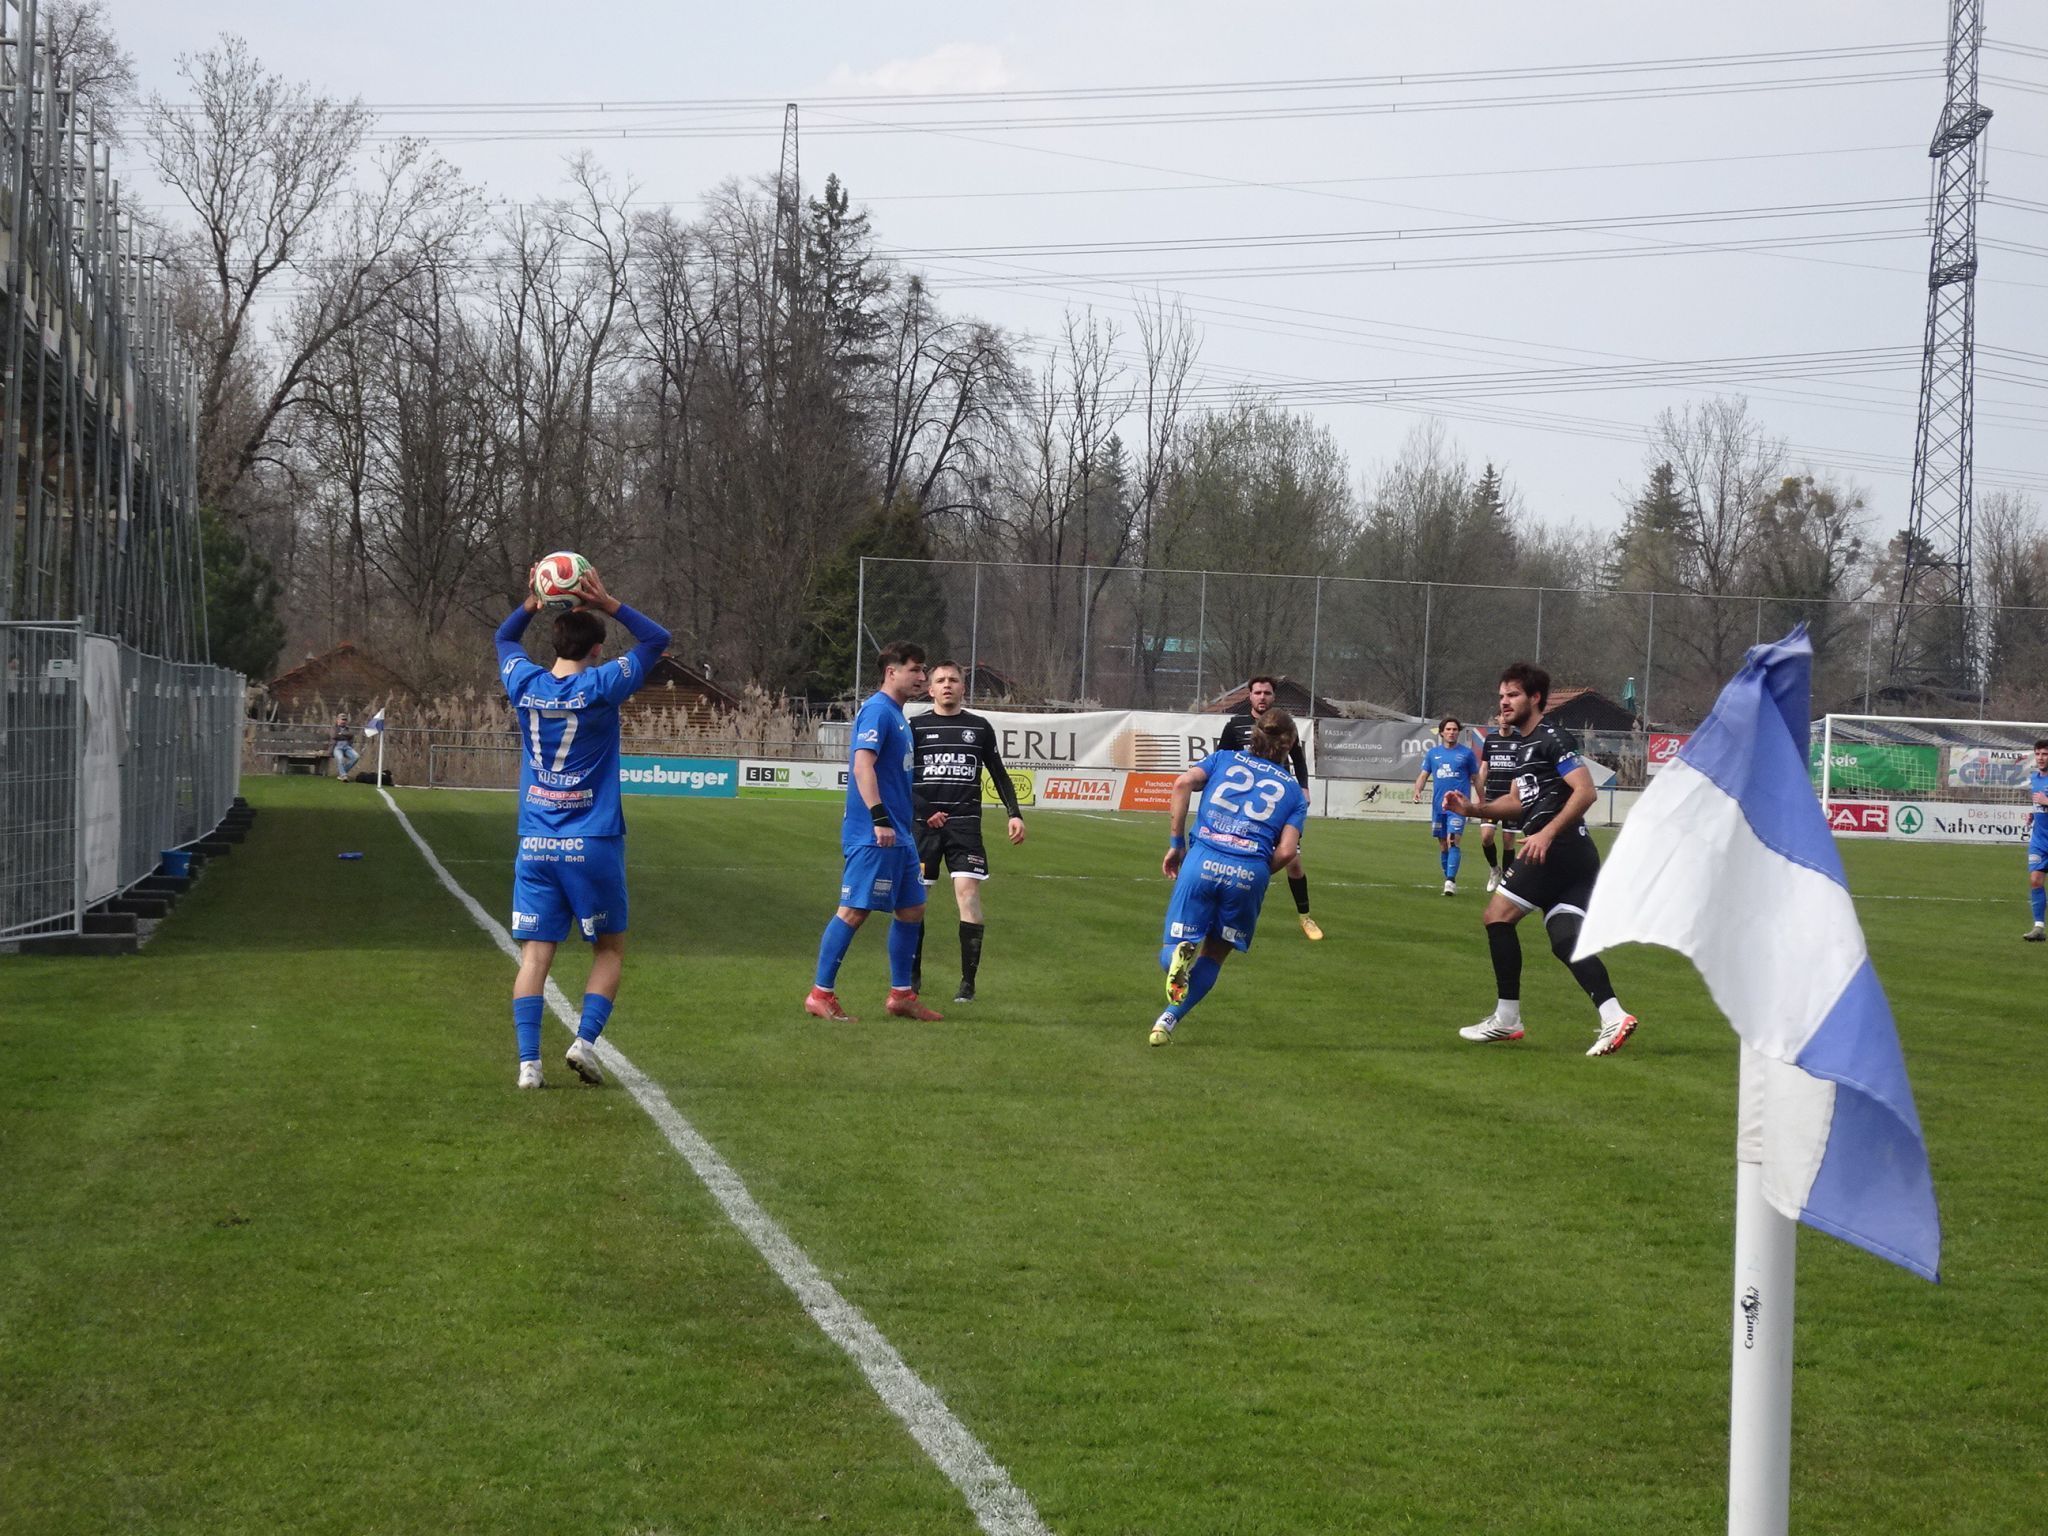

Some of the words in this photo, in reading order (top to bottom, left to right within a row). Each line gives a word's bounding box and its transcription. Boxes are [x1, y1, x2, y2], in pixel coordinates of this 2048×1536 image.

[519, 692, 588, 708] bischof
[528, 708, 578, 772] 17
[934, 753, 966, 763] KOLB
[922, 766, 976, 777] PROTECH
[1046, 780, 1111, 794] FRIMA
[1210, 765, 1286, 821] 23
[1968, 809, 1989, 818] Des
[1993, 809, 2015, 820] isch
[522, 837, 584, 852] aqua-tec
[1203, 859, 1255, 882] aqua-tec
